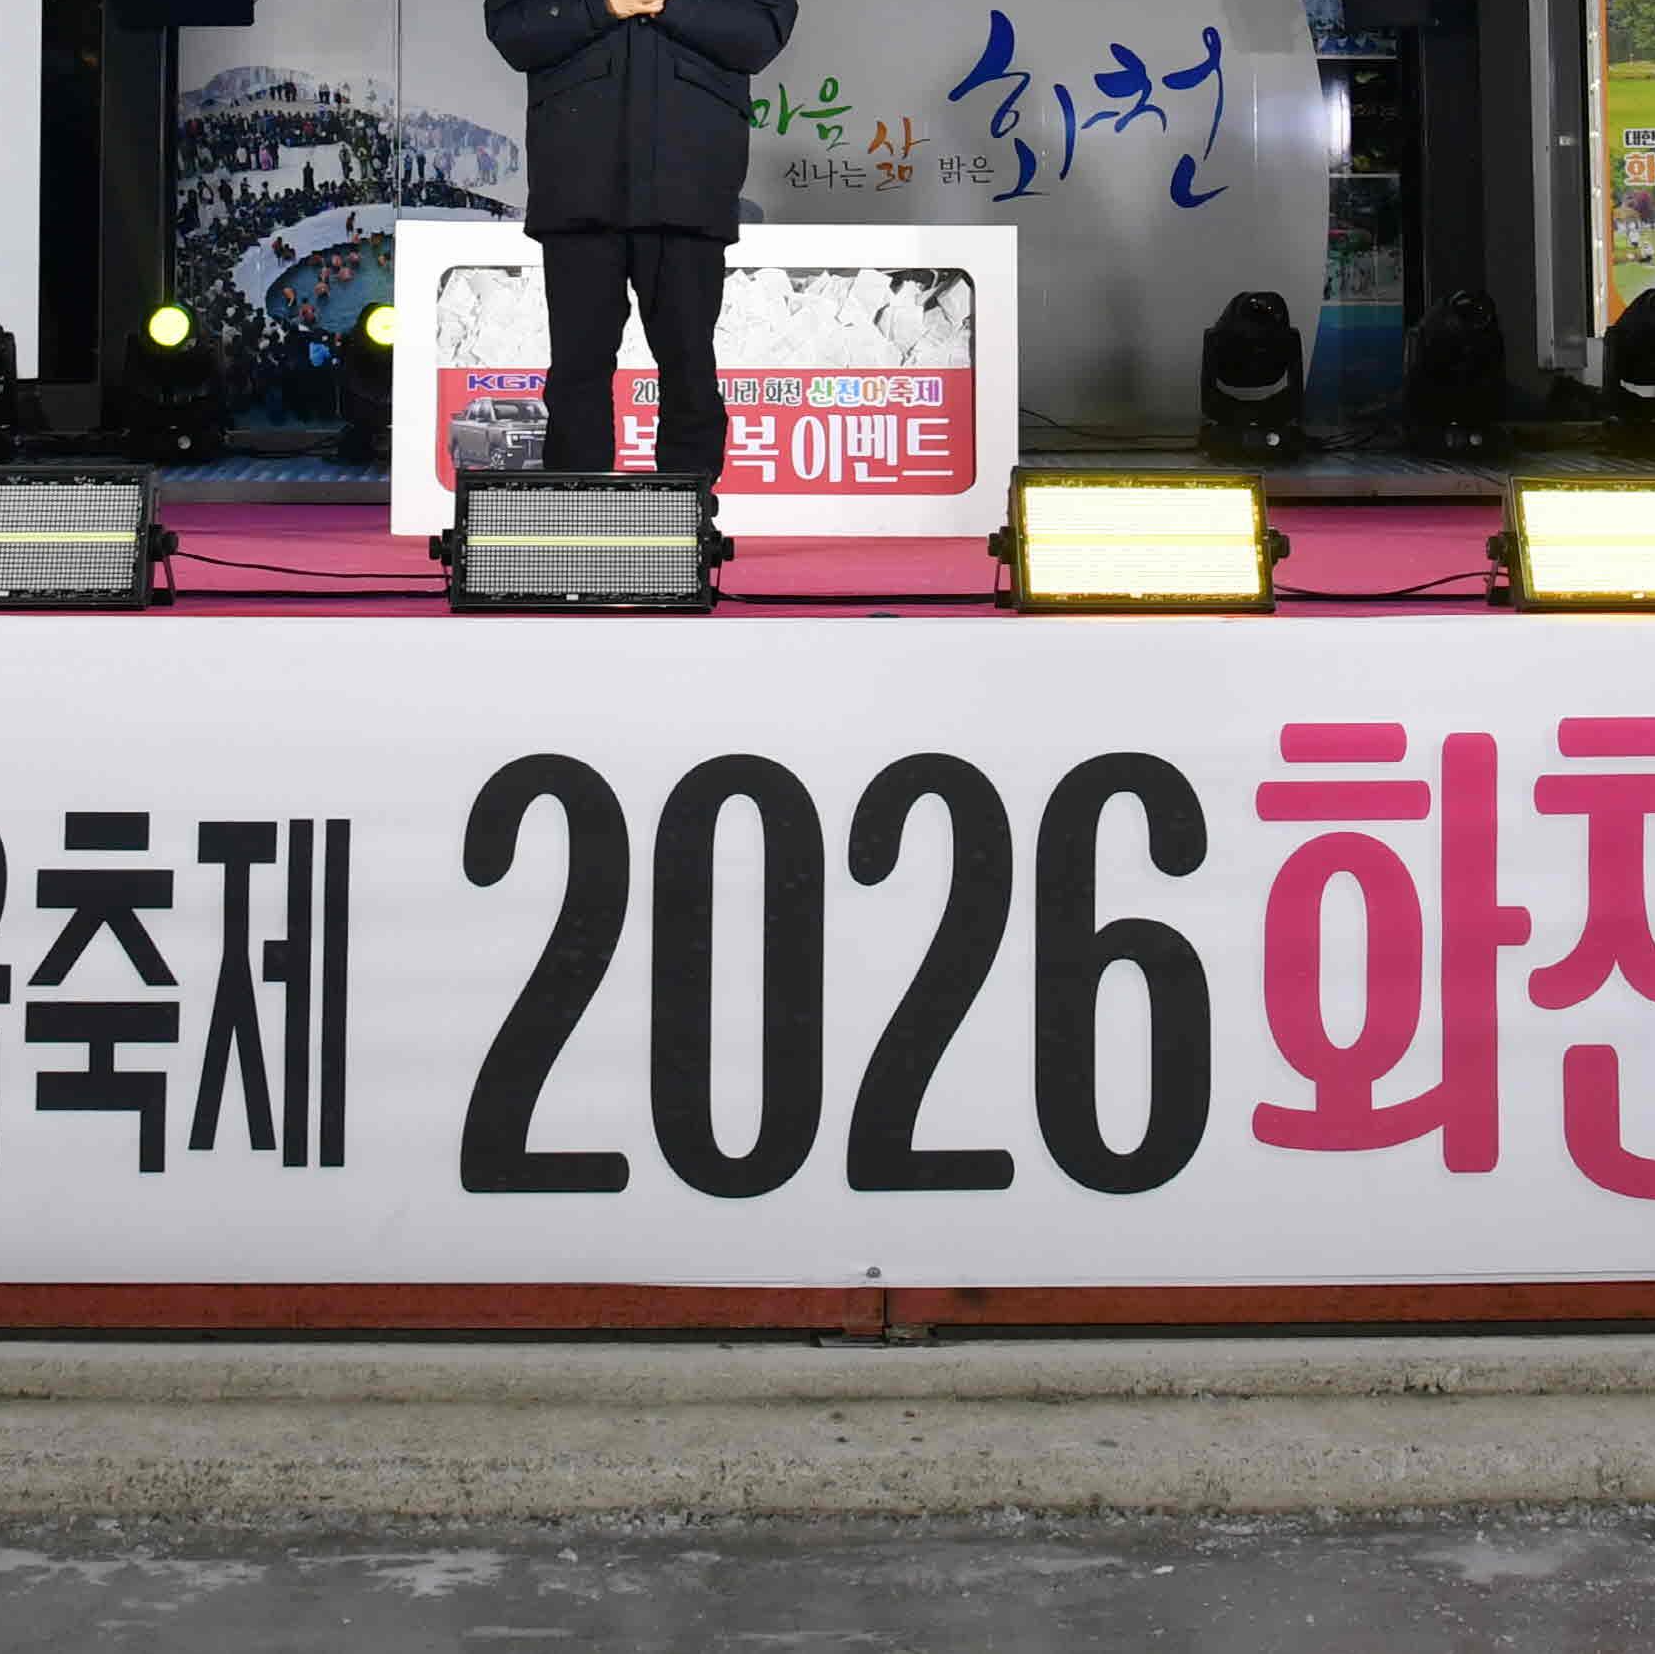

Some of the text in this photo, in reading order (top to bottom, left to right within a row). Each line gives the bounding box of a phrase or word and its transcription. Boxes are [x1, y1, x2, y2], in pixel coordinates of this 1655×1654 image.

[784, 9, 1229, 208] 신나는 삶 밝은 화천
[619, 415, 954, 482] 복복 이벤트
[764, 378, 802, 404] 화천
[807, 376, 942, 406] 산천어축제
[460, 752, 1211, 1199] 2026
